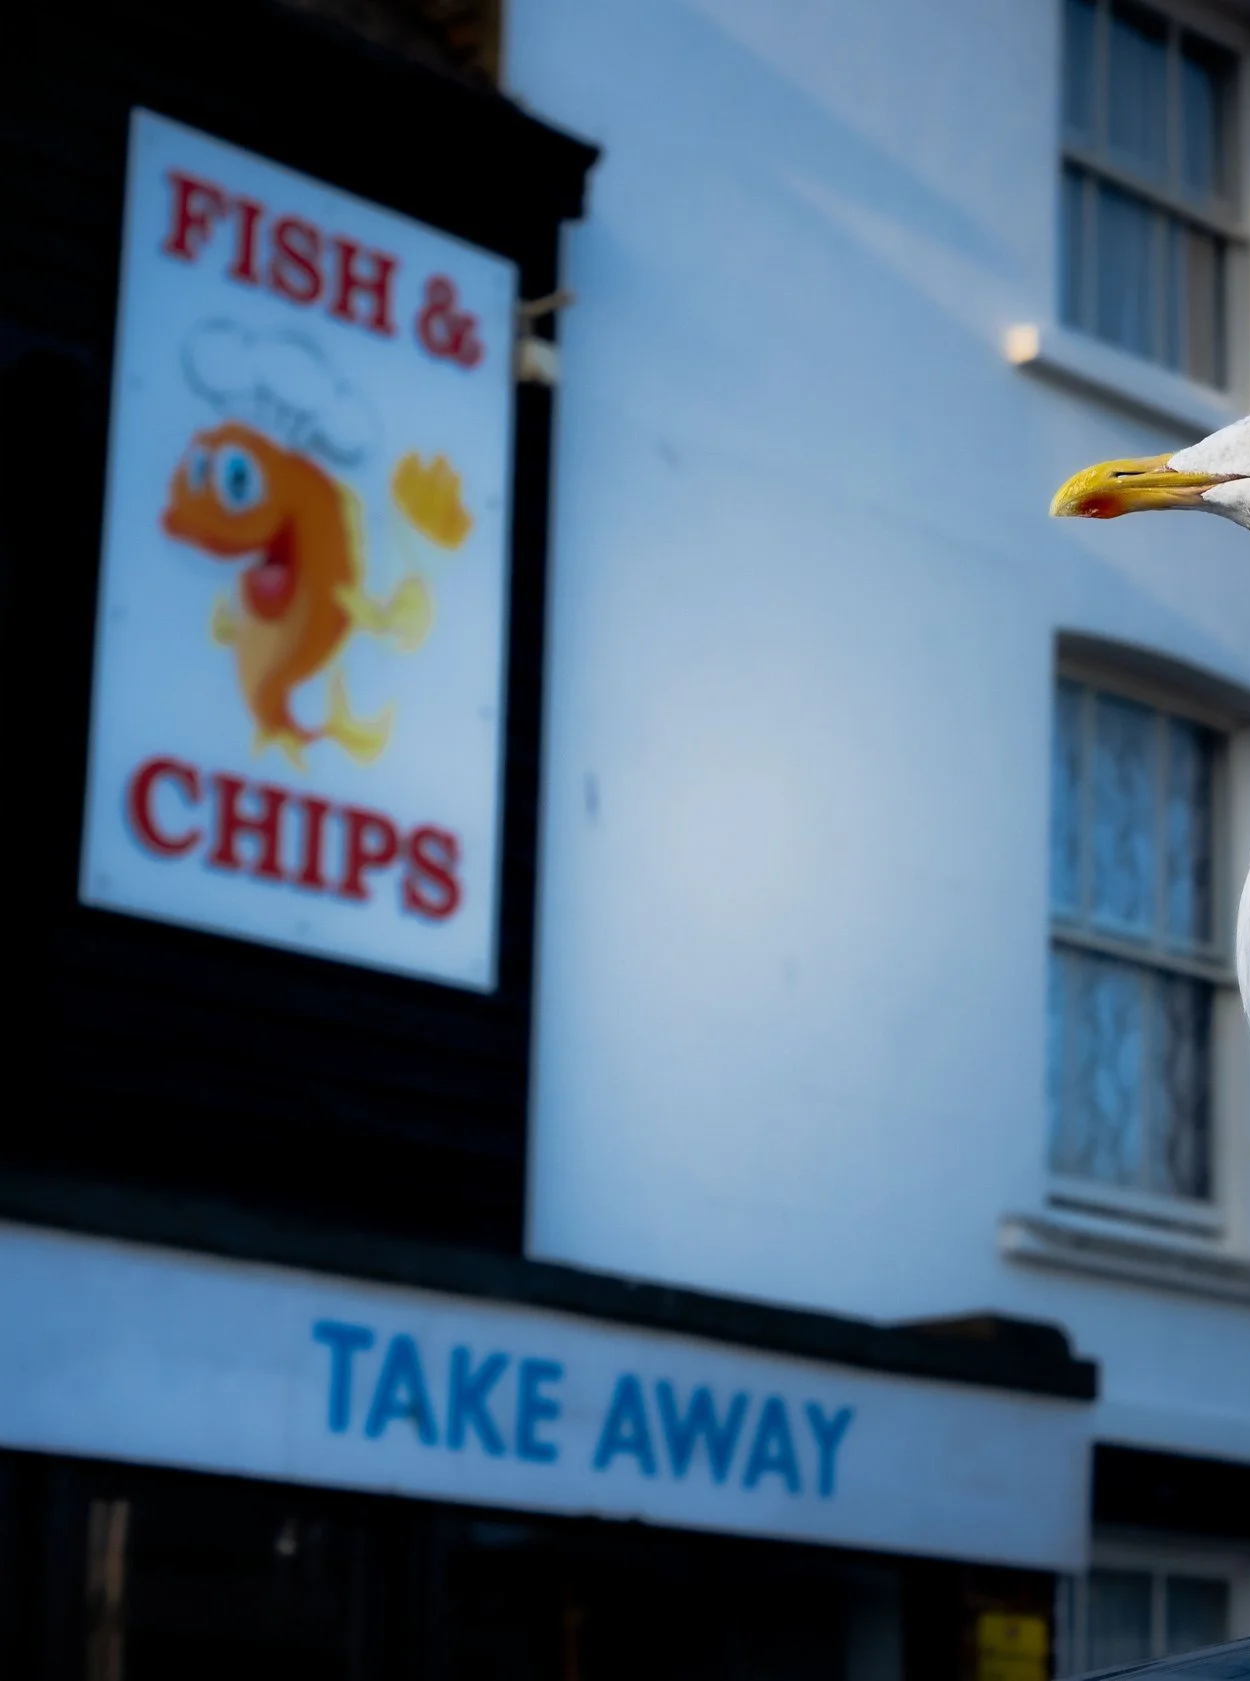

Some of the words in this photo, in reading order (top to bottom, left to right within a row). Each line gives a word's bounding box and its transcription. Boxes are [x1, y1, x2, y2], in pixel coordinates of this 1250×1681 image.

[163, 169, 400, 338] FISH
[417, 275, 483, 370] &
[128, 754, 463, 921] CHIPS
[312, 1319, 564, 1464] TAKE
[592, 1373, 855, 1498] AWAY
